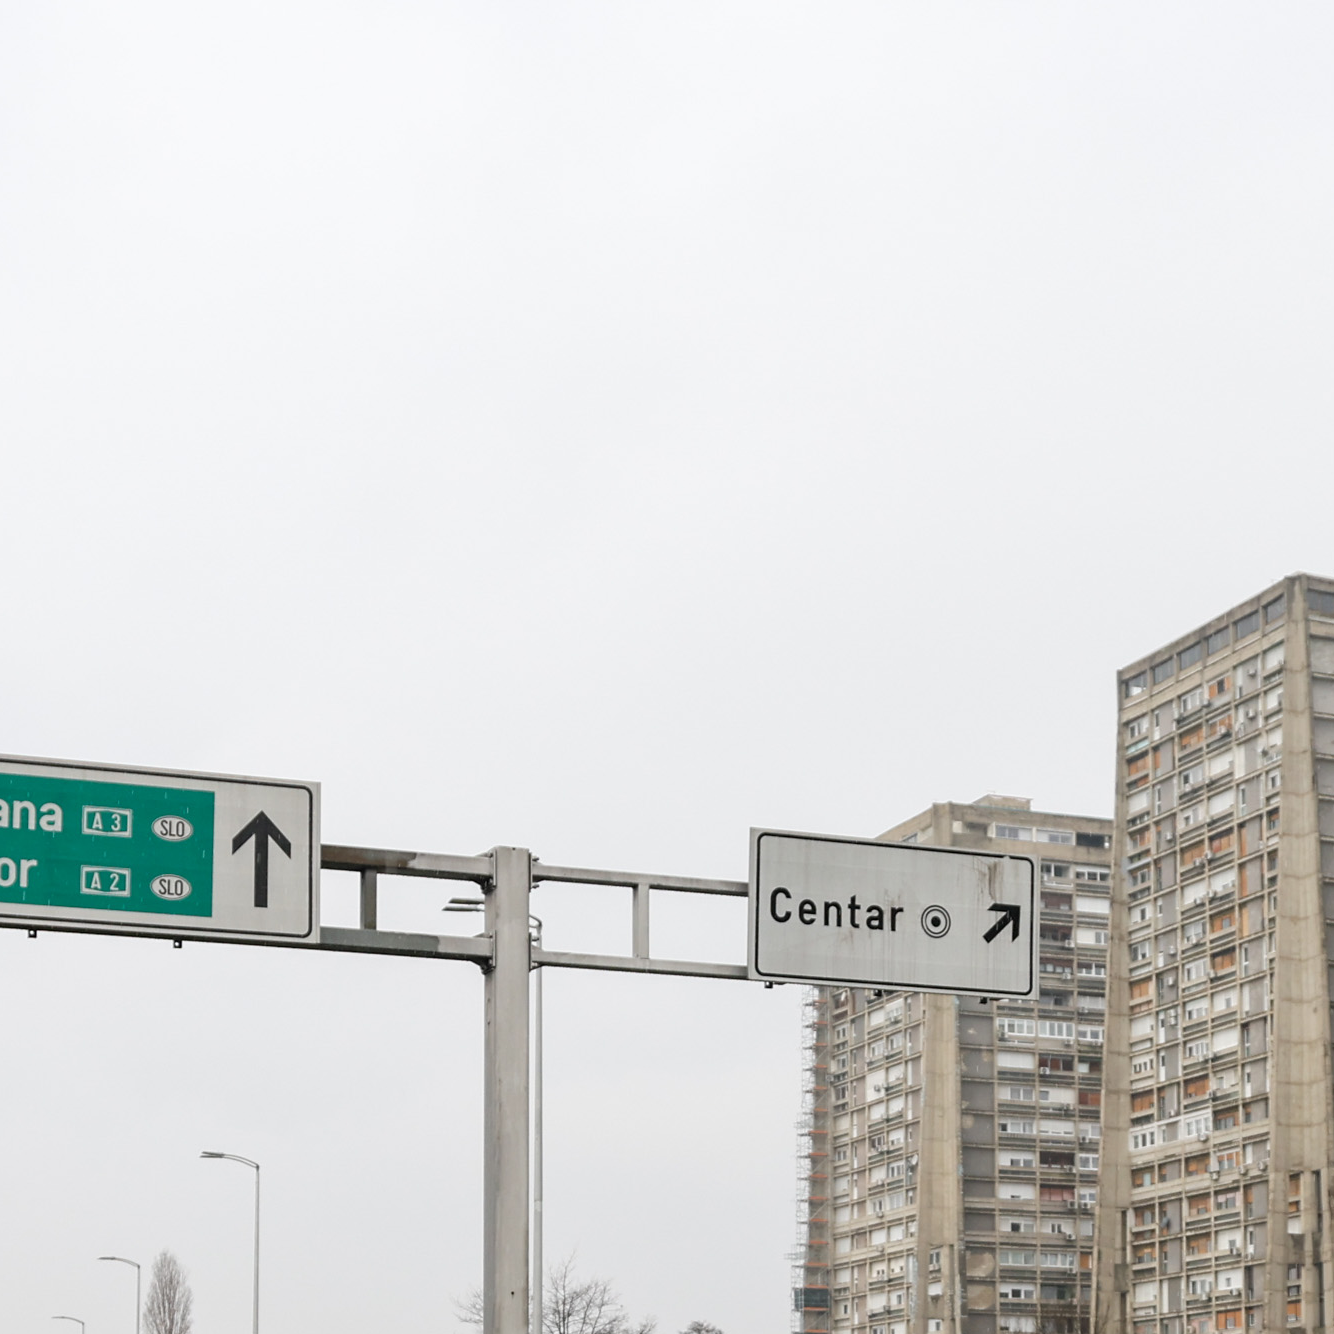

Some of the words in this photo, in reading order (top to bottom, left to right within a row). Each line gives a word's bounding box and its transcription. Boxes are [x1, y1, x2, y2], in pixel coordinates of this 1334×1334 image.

[160, 819, 185, 838] SLO
[158, 878, 184, 897] SLO
[770, 887, 904, 932] Centar
